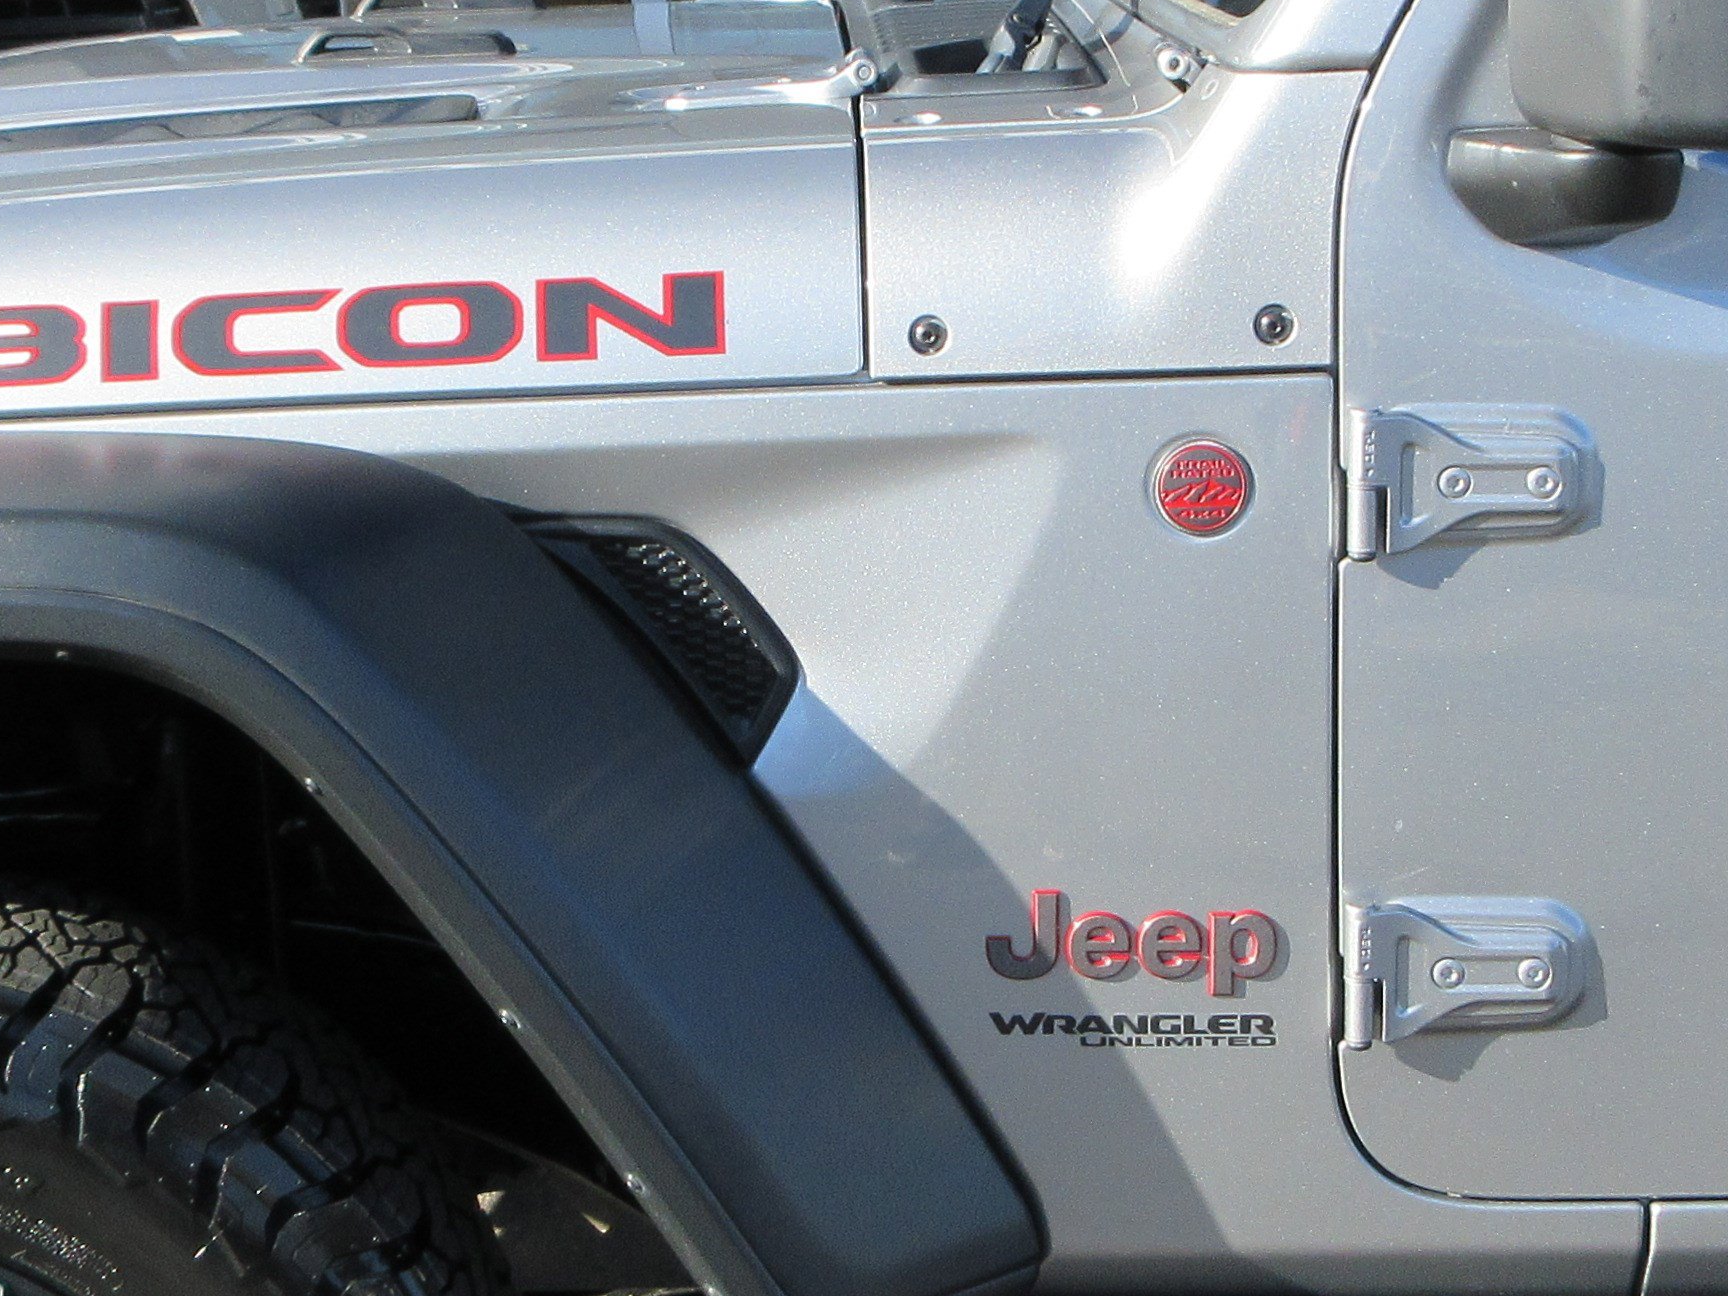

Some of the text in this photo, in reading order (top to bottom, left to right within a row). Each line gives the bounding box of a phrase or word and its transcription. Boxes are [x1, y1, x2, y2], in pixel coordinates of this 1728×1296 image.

[985, 889, 1278, 997] Jeep
[988, 1011, 1276, 1037] WRANGLER
[1078, 1036, 1278, 1048] UNLIMITED
